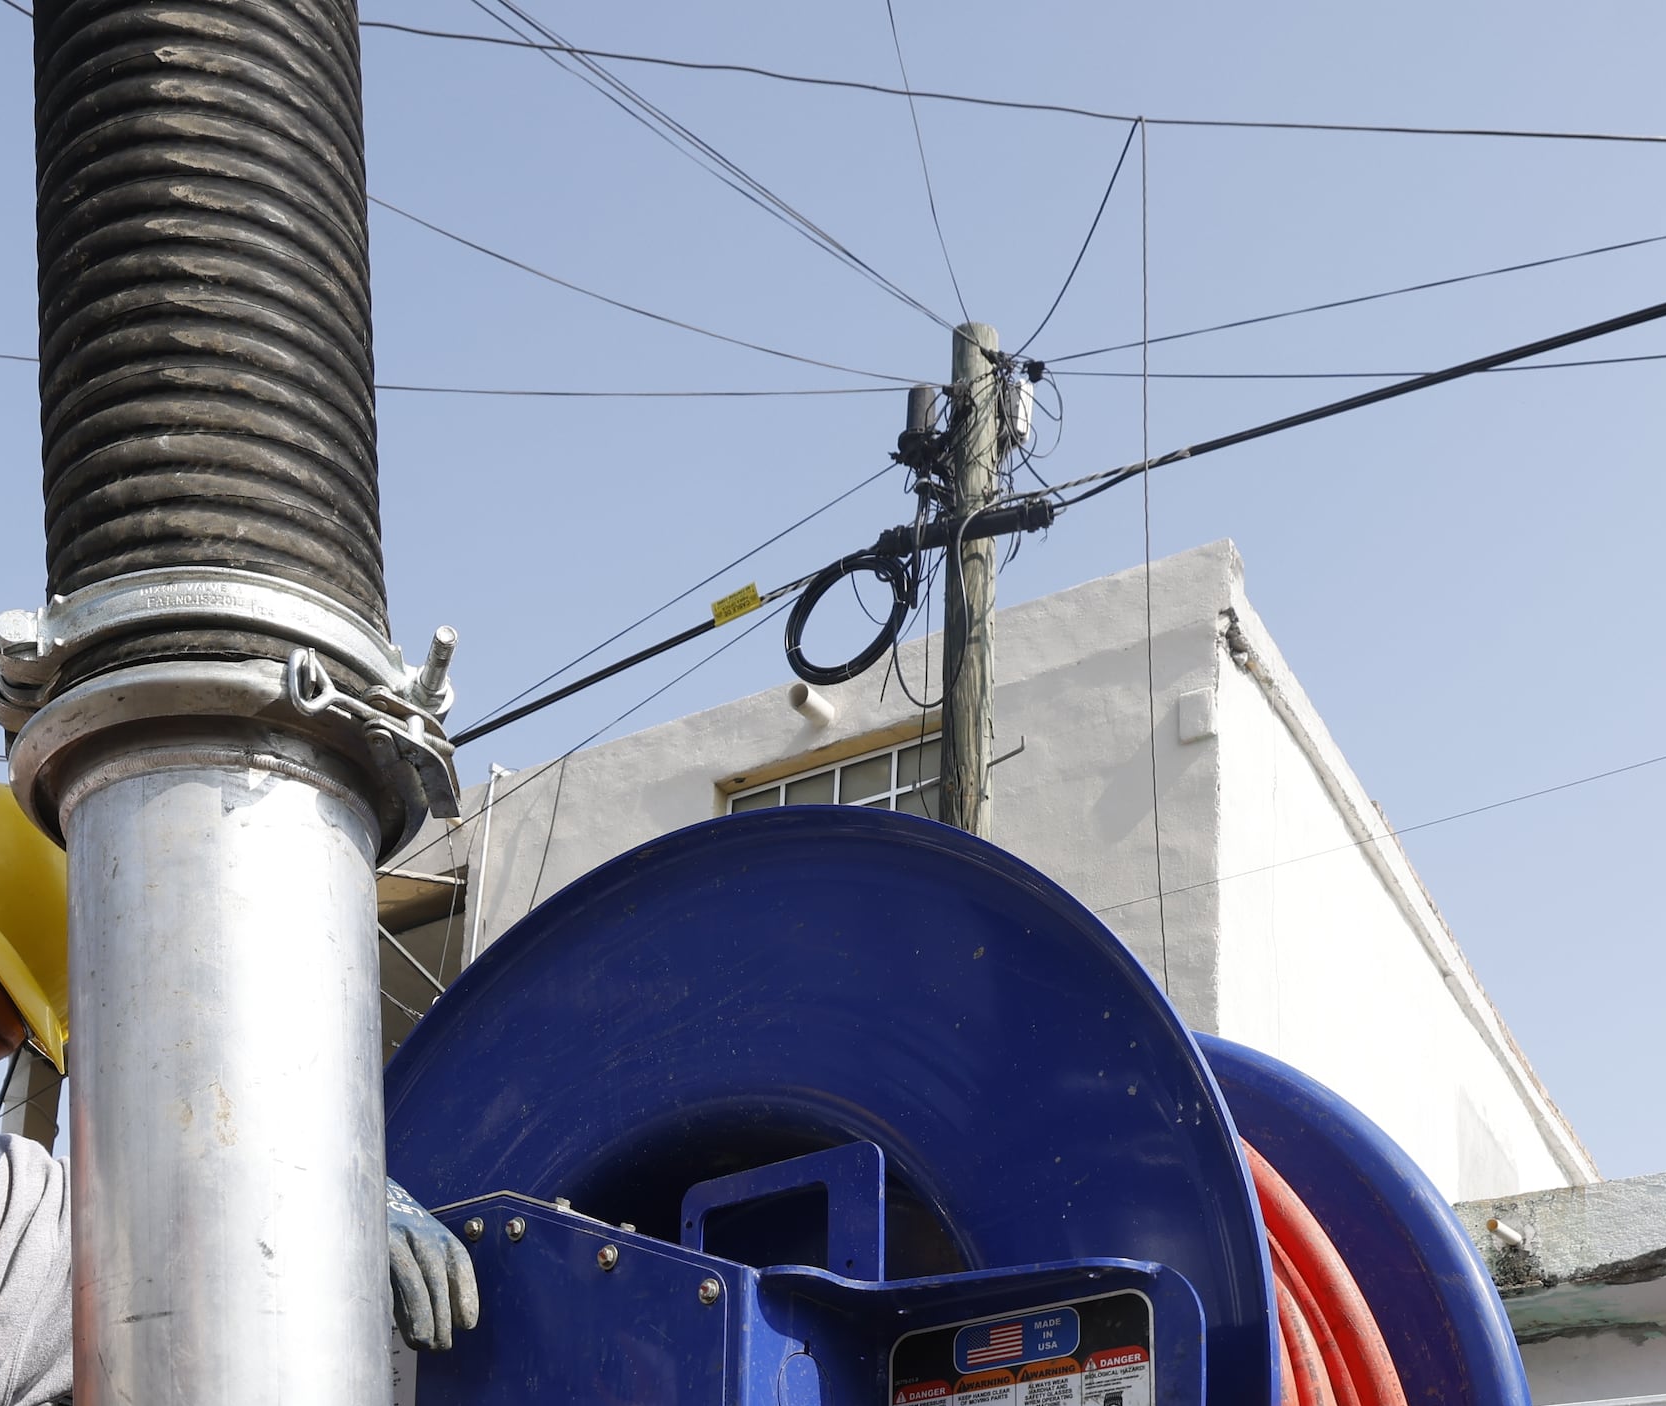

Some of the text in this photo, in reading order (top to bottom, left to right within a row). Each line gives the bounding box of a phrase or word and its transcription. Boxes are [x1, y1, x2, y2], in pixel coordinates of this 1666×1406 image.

[1034, 1317, 1061, 1329] MADE
[1042, 1330, 1052, 1339] IN
[1037, 1340, 1057, 1351] USA
[1100, 1352, 1140, 1367] DANGER
[1030, 1364, 1075, 1378] WARNING
[967, 1375, 1009, 1390] WARNING
[909, 1386, 945, 1400] DANGER
